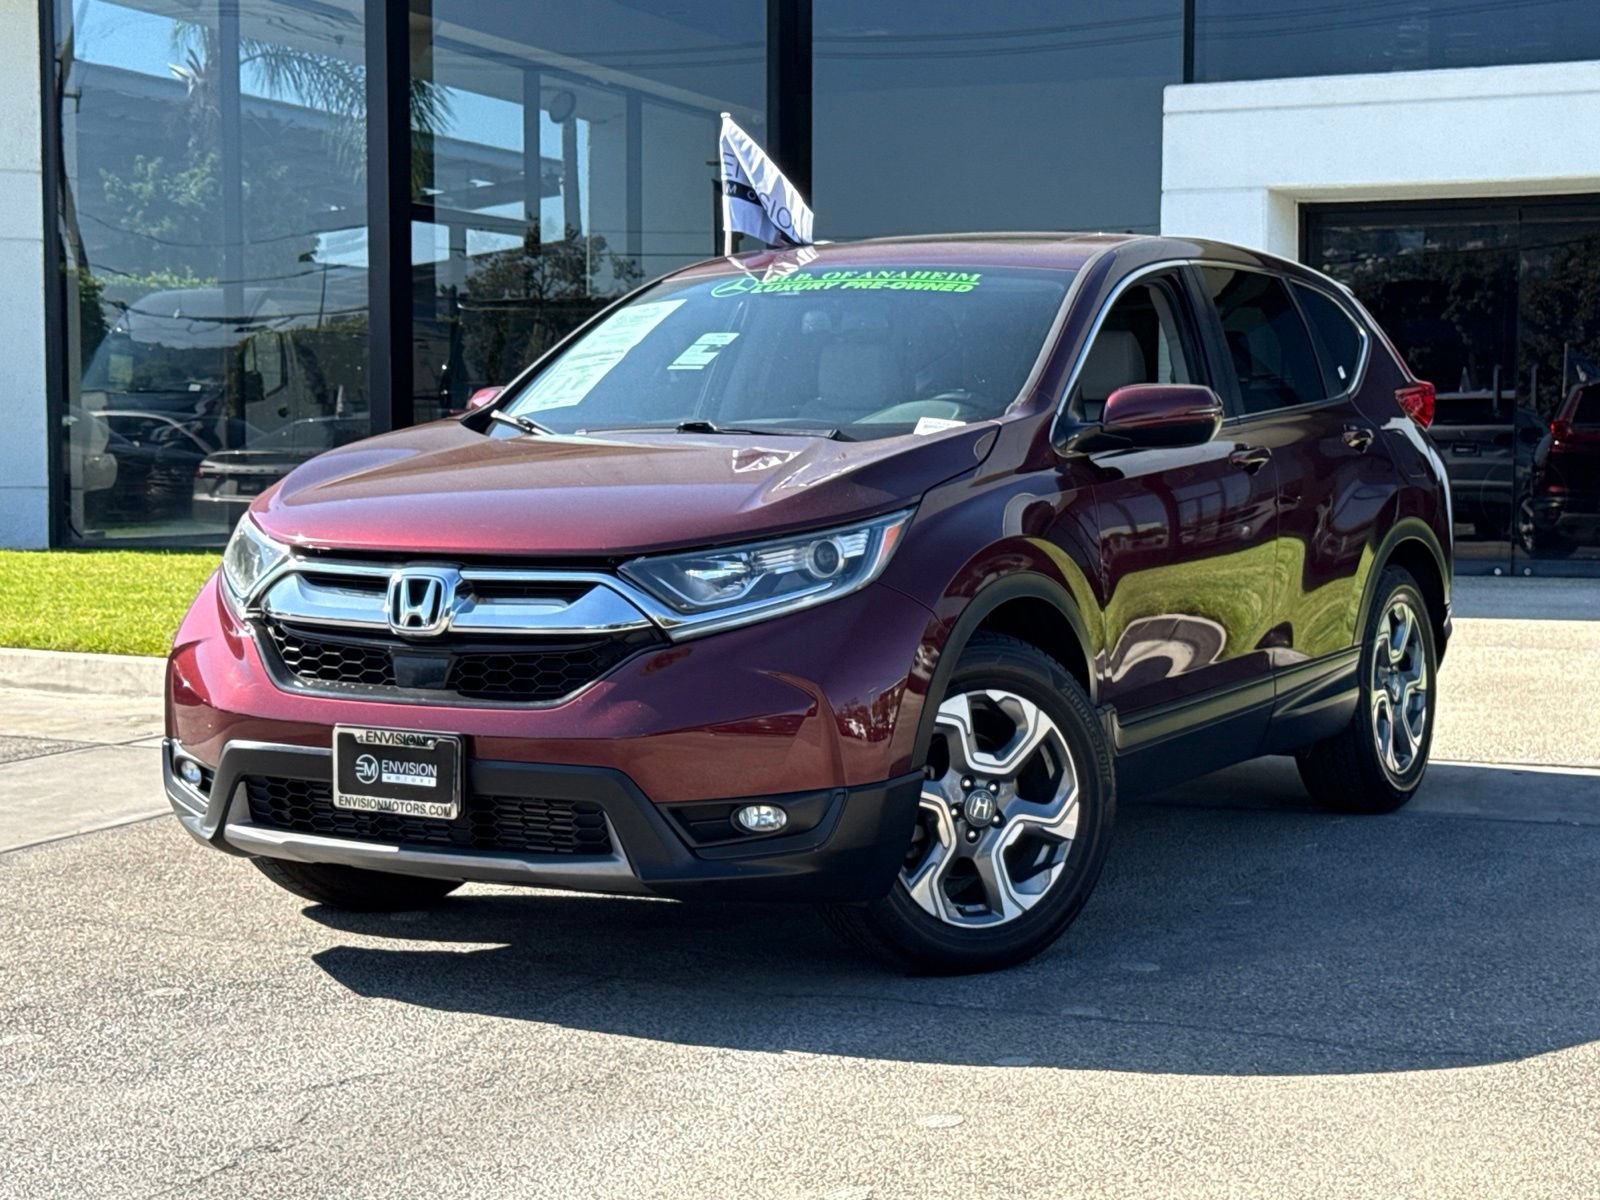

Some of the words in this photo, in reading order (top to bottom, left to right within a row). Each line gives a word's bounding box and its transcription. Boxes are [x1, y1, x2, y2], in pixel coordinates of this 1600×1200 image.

[822, 271, 858, 280] OF
[856, 270, 982, 282] ANAHEIM
[750, 281, 840, 294] LUXURY
[840, 281, 975, 293] PRE-OWNED
[365, 731, 425, 746] ENVISION
[382, 760, 437, 777] ENVISION
[338, 796, 452, 818] ENVISIONMOTORS.COM
